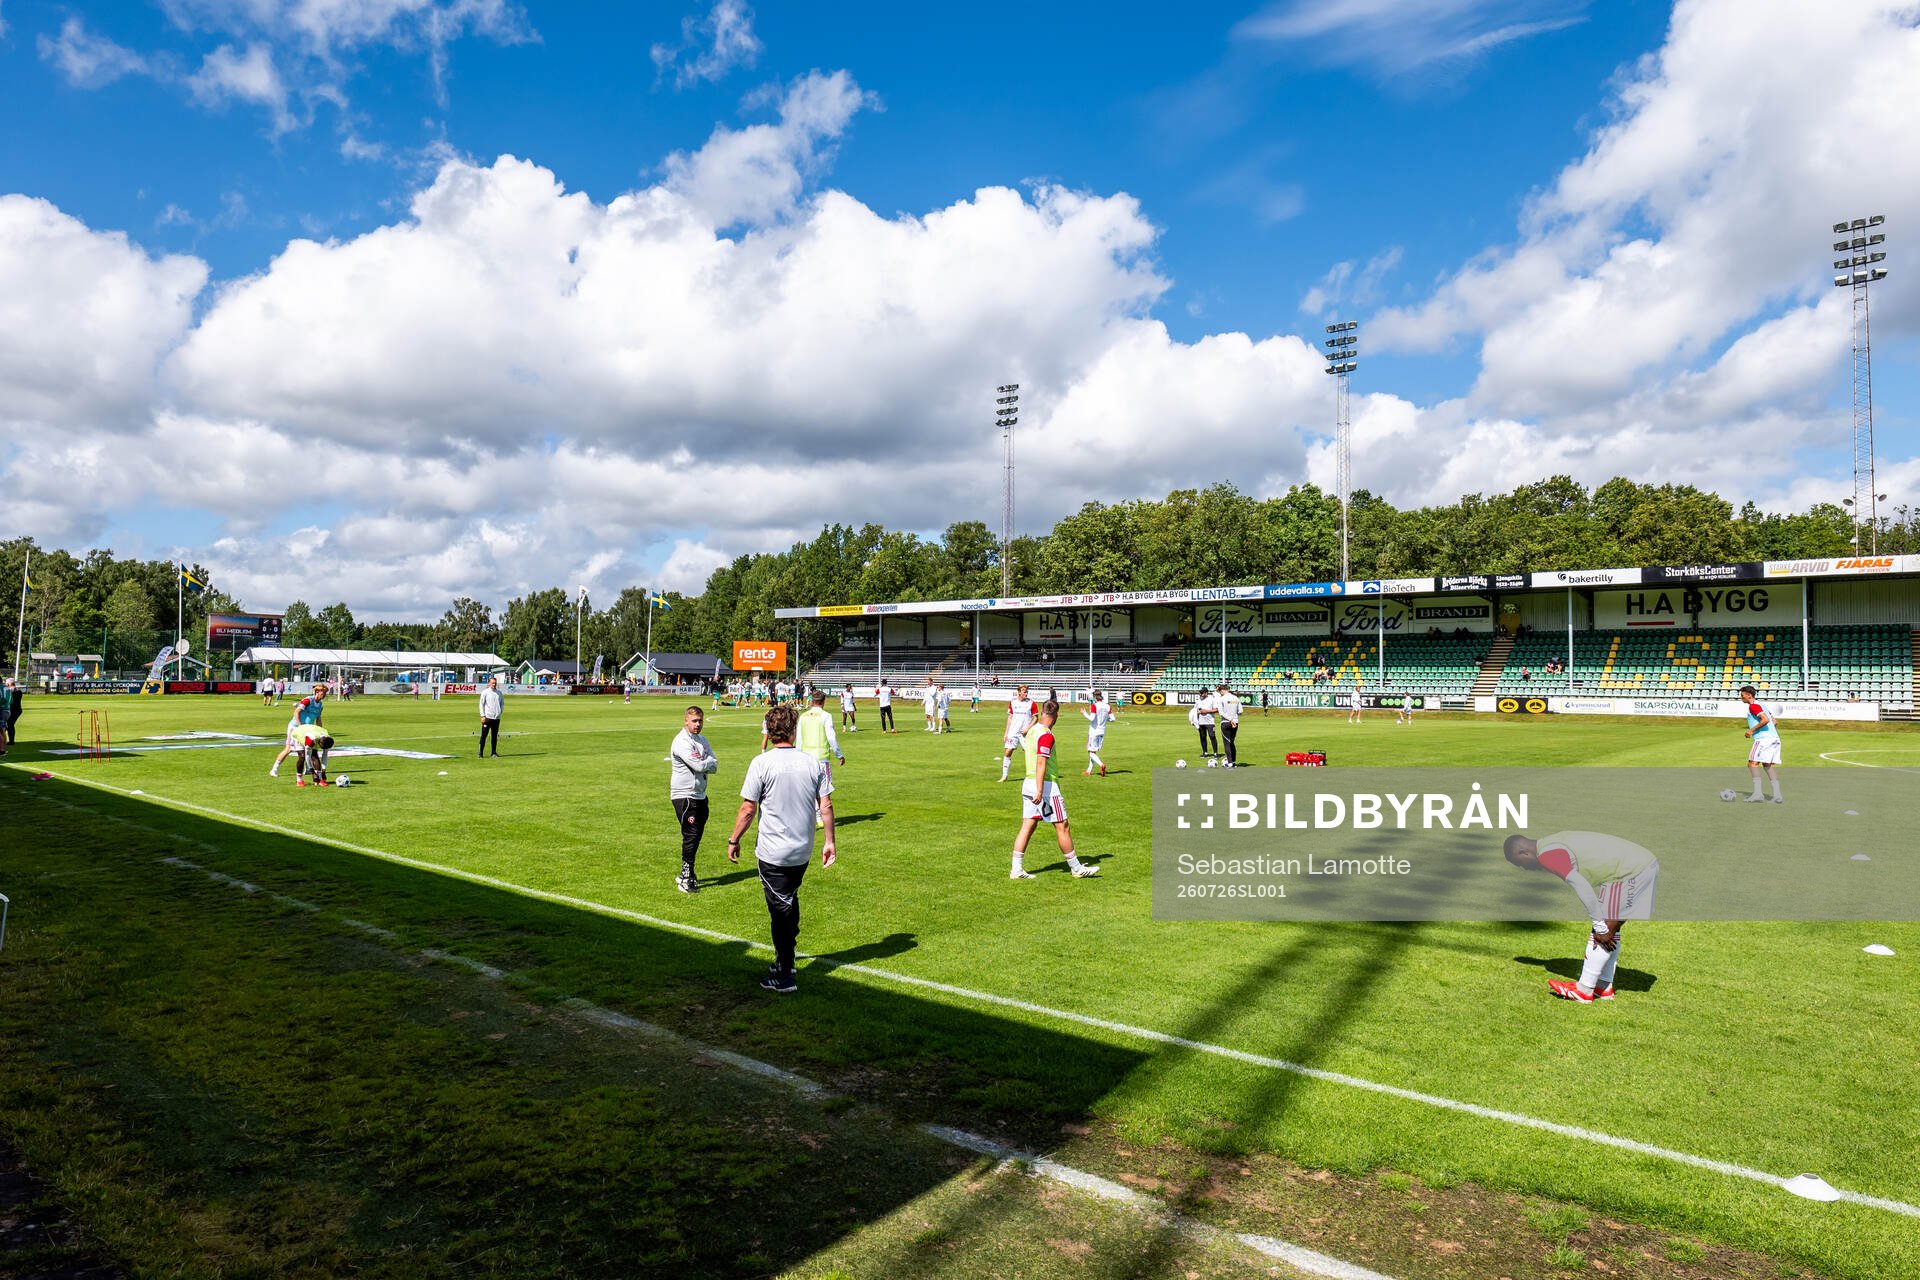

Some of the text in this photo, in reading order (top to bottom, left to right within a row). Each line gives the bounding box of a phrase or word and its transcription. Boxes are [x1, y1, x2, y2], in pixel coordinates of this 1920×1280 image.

[1791, 561, 1830, 573] ARVID
[1568, 573, 1613, 583] bakertilly
[1269, 586, 1324, 596] uddevalla.se
[1383, 584, 1415, 593] BioTech
[1135, 592, 1154, 600] BYGG
[1169, 590, 1189, 598] BYGG
[1191, 589, 1236, 600] LLENTAB
[1626, 589, 1769, 615] H.A BYGG
[1269, 612, 1325, 622] BRANDT
[1420, 607, 1486, 617] BRANDT
[1039, 612, 1112, 630] H.A BYGG
[1199, 609, 1255, 634] Ford
[1339, 604, 1404, 631] Ford
[739, 647, 776, 659] renta
[445, 683, 477, 693] EL-Vast
[1267, 695, 1318, 706] SUPERETTAN
[1335, 697, 1376, 706] UNET
